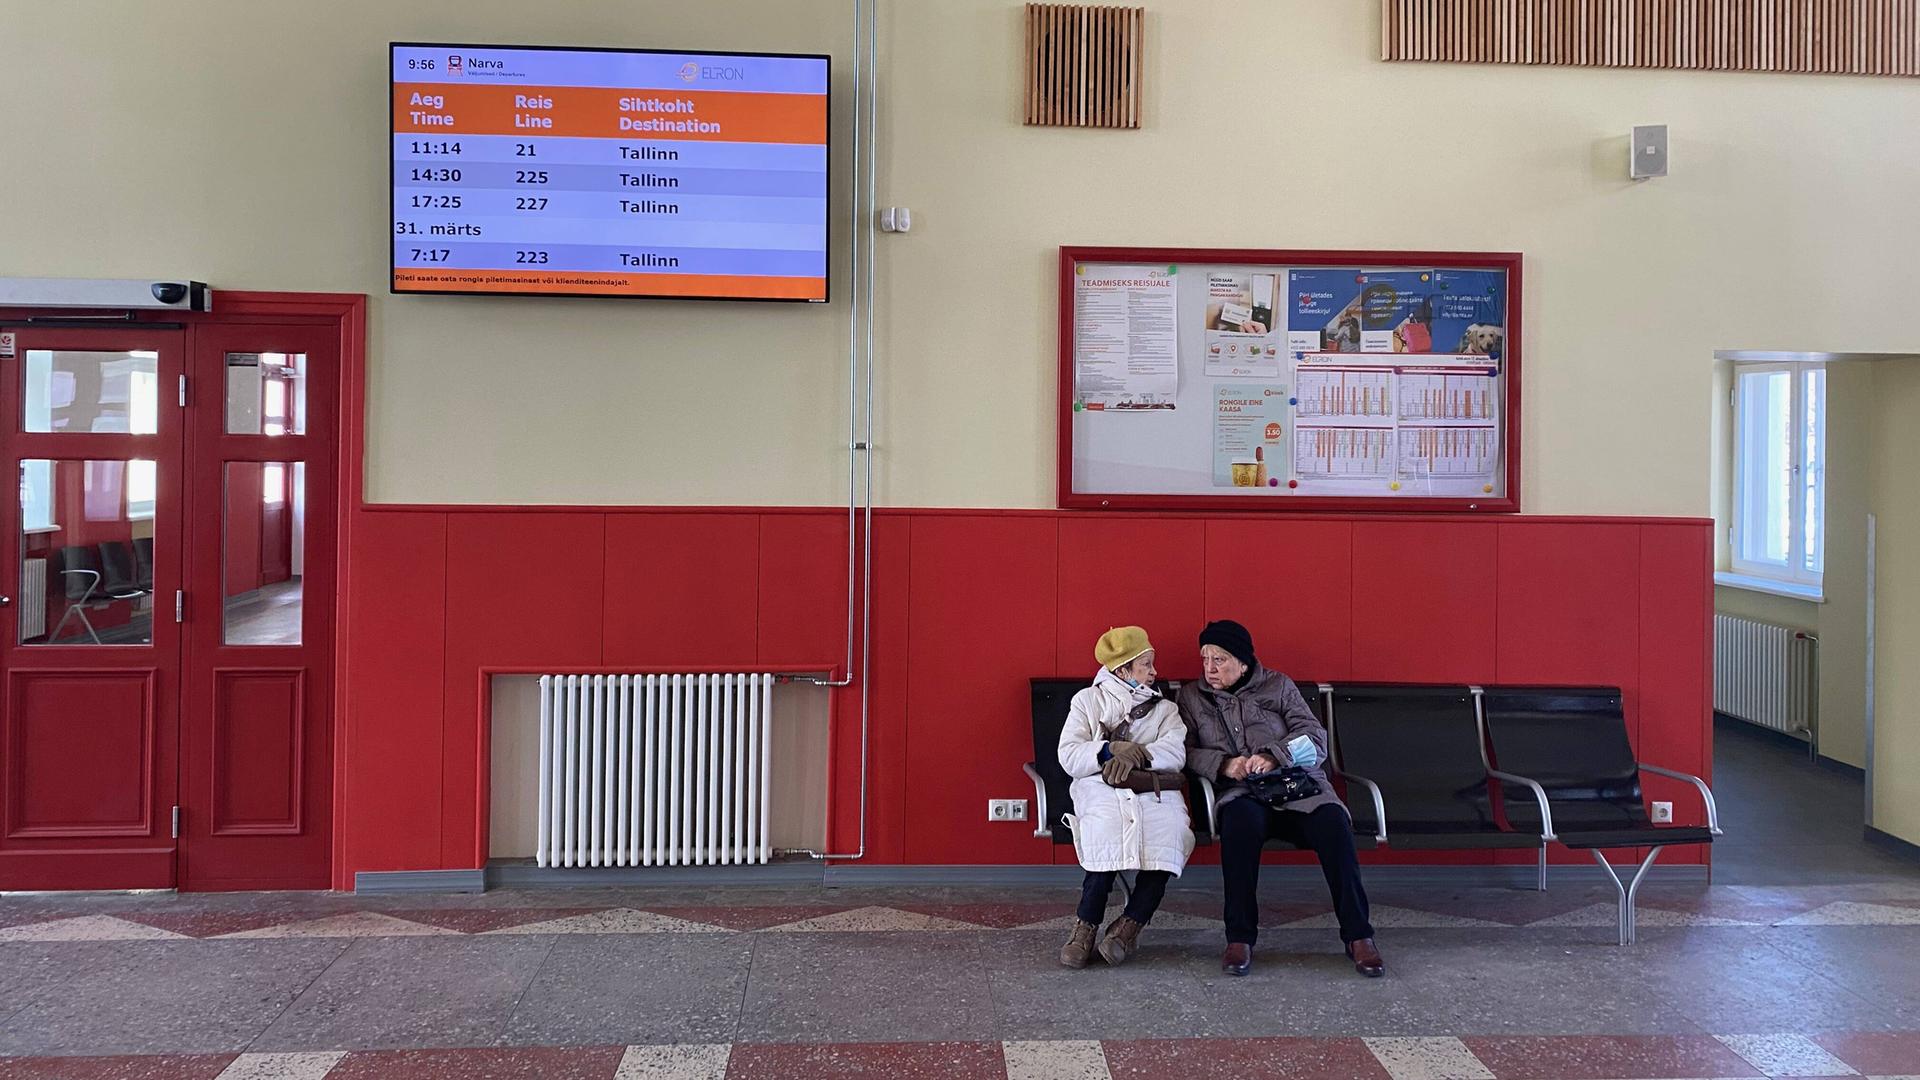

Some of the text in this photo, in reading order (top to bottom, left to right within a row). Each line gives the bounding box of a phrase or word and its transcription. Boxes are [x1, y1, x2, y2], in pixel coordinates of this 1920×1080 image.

[408, 59, 435, 70] 9:56
[468, 58, 504, 69] Narva
[702, 67, 744, 80] ELRON
[410, 92, 444, 109] Aeg
[515, 95, 553, 109] Reis
[619, 97, 694, 113] Sihtkoht
[410, 111, 454, 126] Time
[515, 113, 553, 128] Line
[619, 116, 720, 133] Destination
[411, 141, 462, 155] 11:14
[516, 144, 536, 156] 21
[619, 147, 679, 160] Tallinn
[411, 168, 462, 181] 14:30
[516, 171, 549, 183] 225
[619, 174, 679, 187] Tallinn
[411, 195, 462, 208] 17:25
[516, 198, 549, 210] 227
[619, 200, 679, 214] Tallinn
[396, 222, 482, 236] 31. märts
[411, 249, 450, 261] 7:17
[516, 251, 549, 264] 223
[619, 254, 679, 267] Tallinn
[486, 276, 540, 284] piletimasinast
[556, 278, 630, 286] klienditeenindajalt.
[1082, 279, 1132, 287] TEADMISEKS
